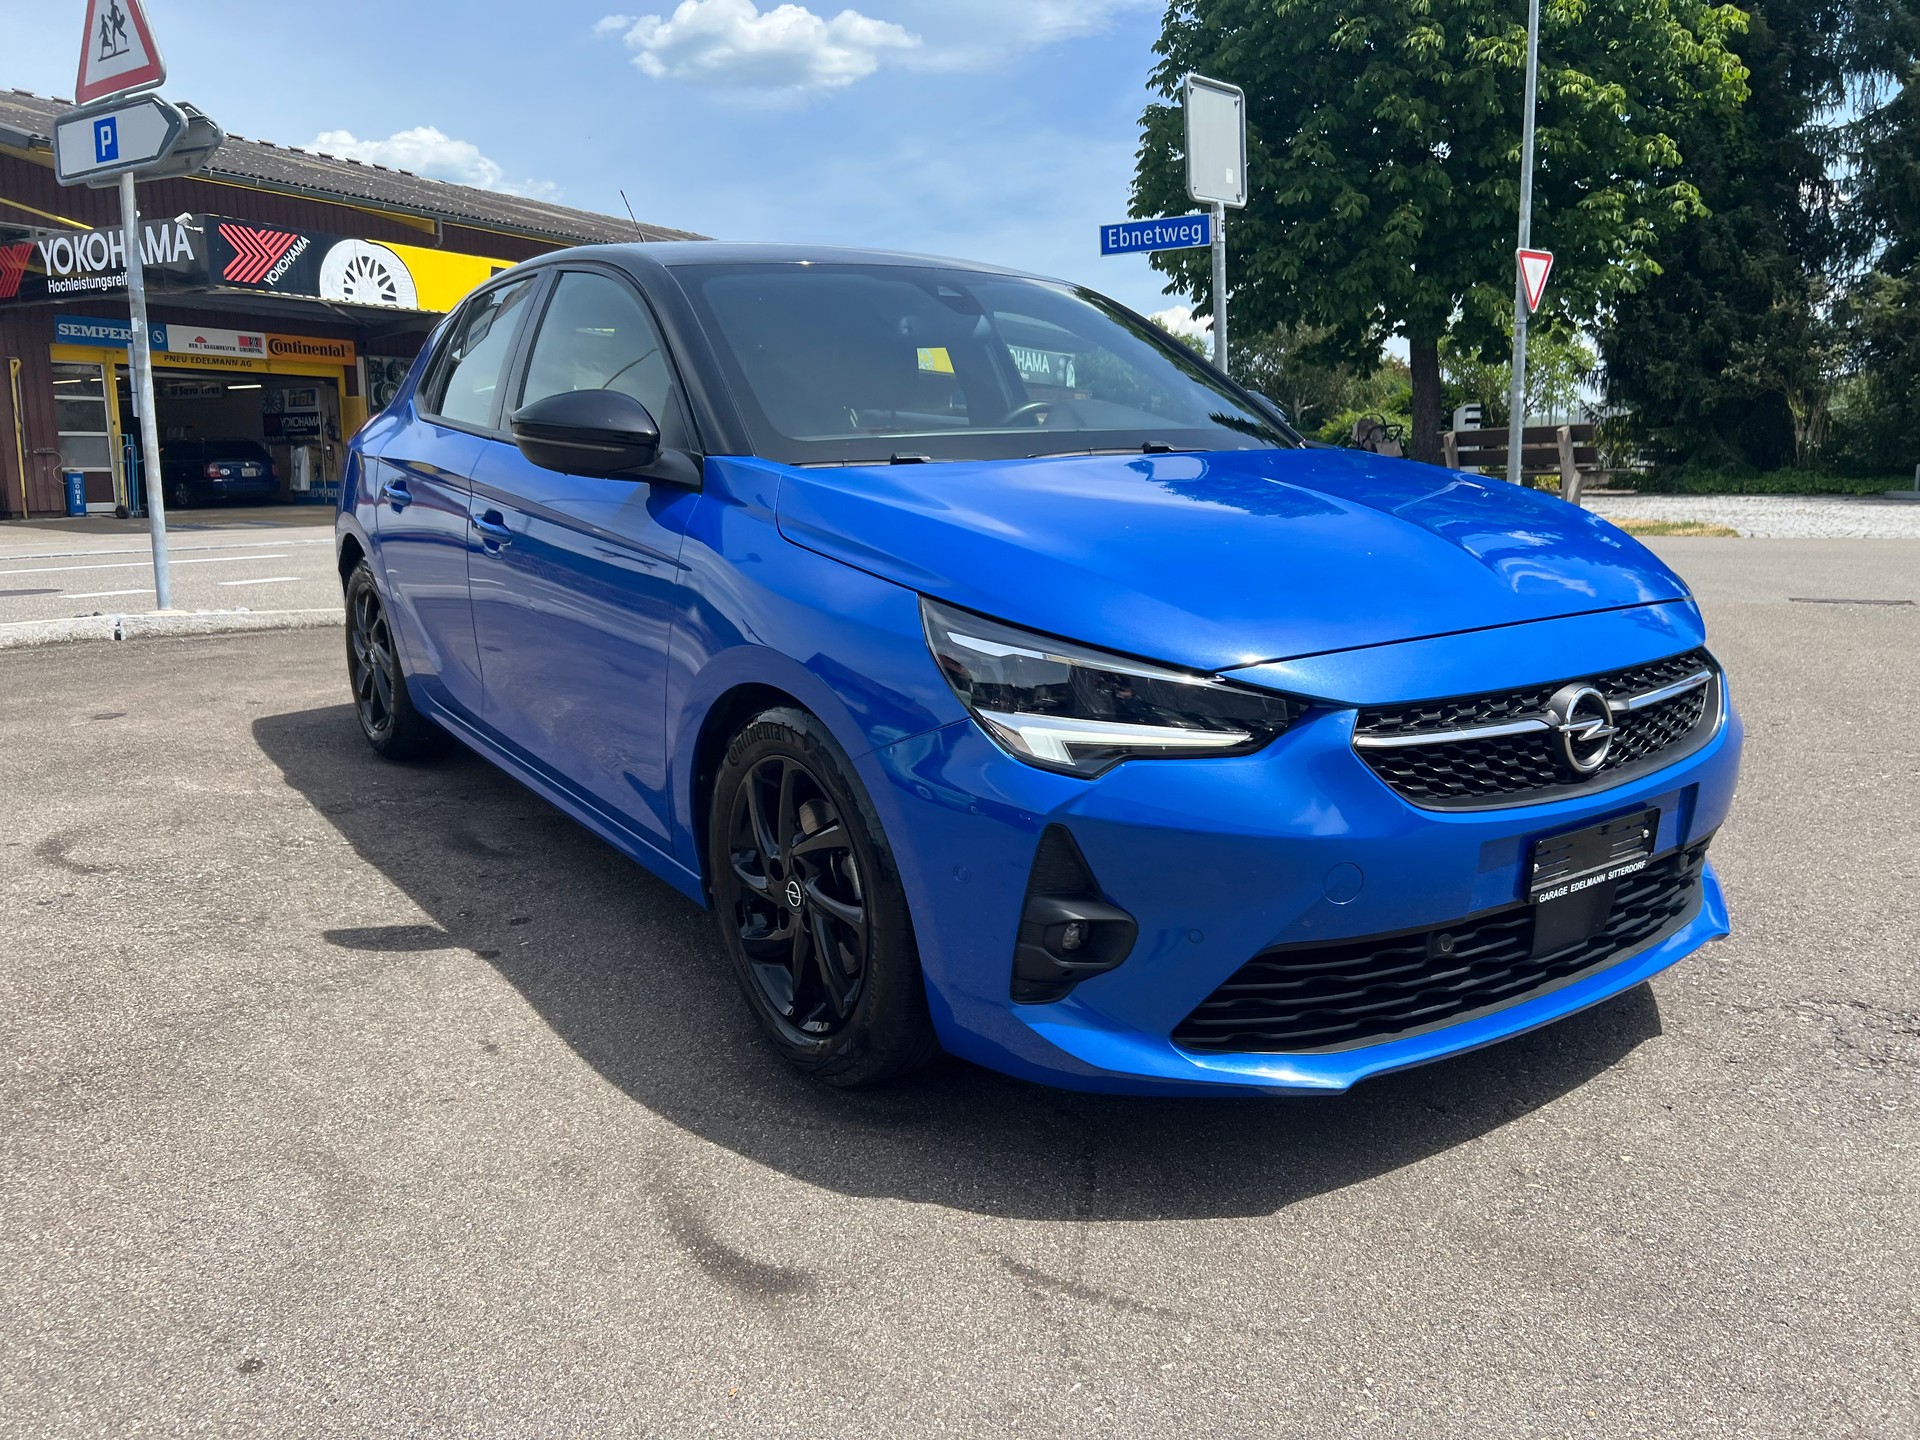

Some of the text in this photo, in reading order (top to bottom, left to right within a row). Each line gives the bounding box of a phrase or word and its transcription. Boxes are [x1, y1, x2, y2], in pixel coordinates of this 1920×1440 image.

[100, 125, 112, 156] P
[1108, 223, 1202, 249] Ebnetweg
[263, 235, 311, 286] YOKOHAMA
[48, 272, 128, 293] Hochleistungsreif
[58, 323, 133, 340] SEMPER
[268, 338, 346, 357] Continental
[164, 354, 187, 363] PNEU
[191, 356, 238, 366] EDELMANN
[280, 415, 320, 428] YOKOHAMA
[728, 724, 786, 767] Continental
[1539, 860, 1647, 903] GARAGE EDELMANN SITTERDORF
